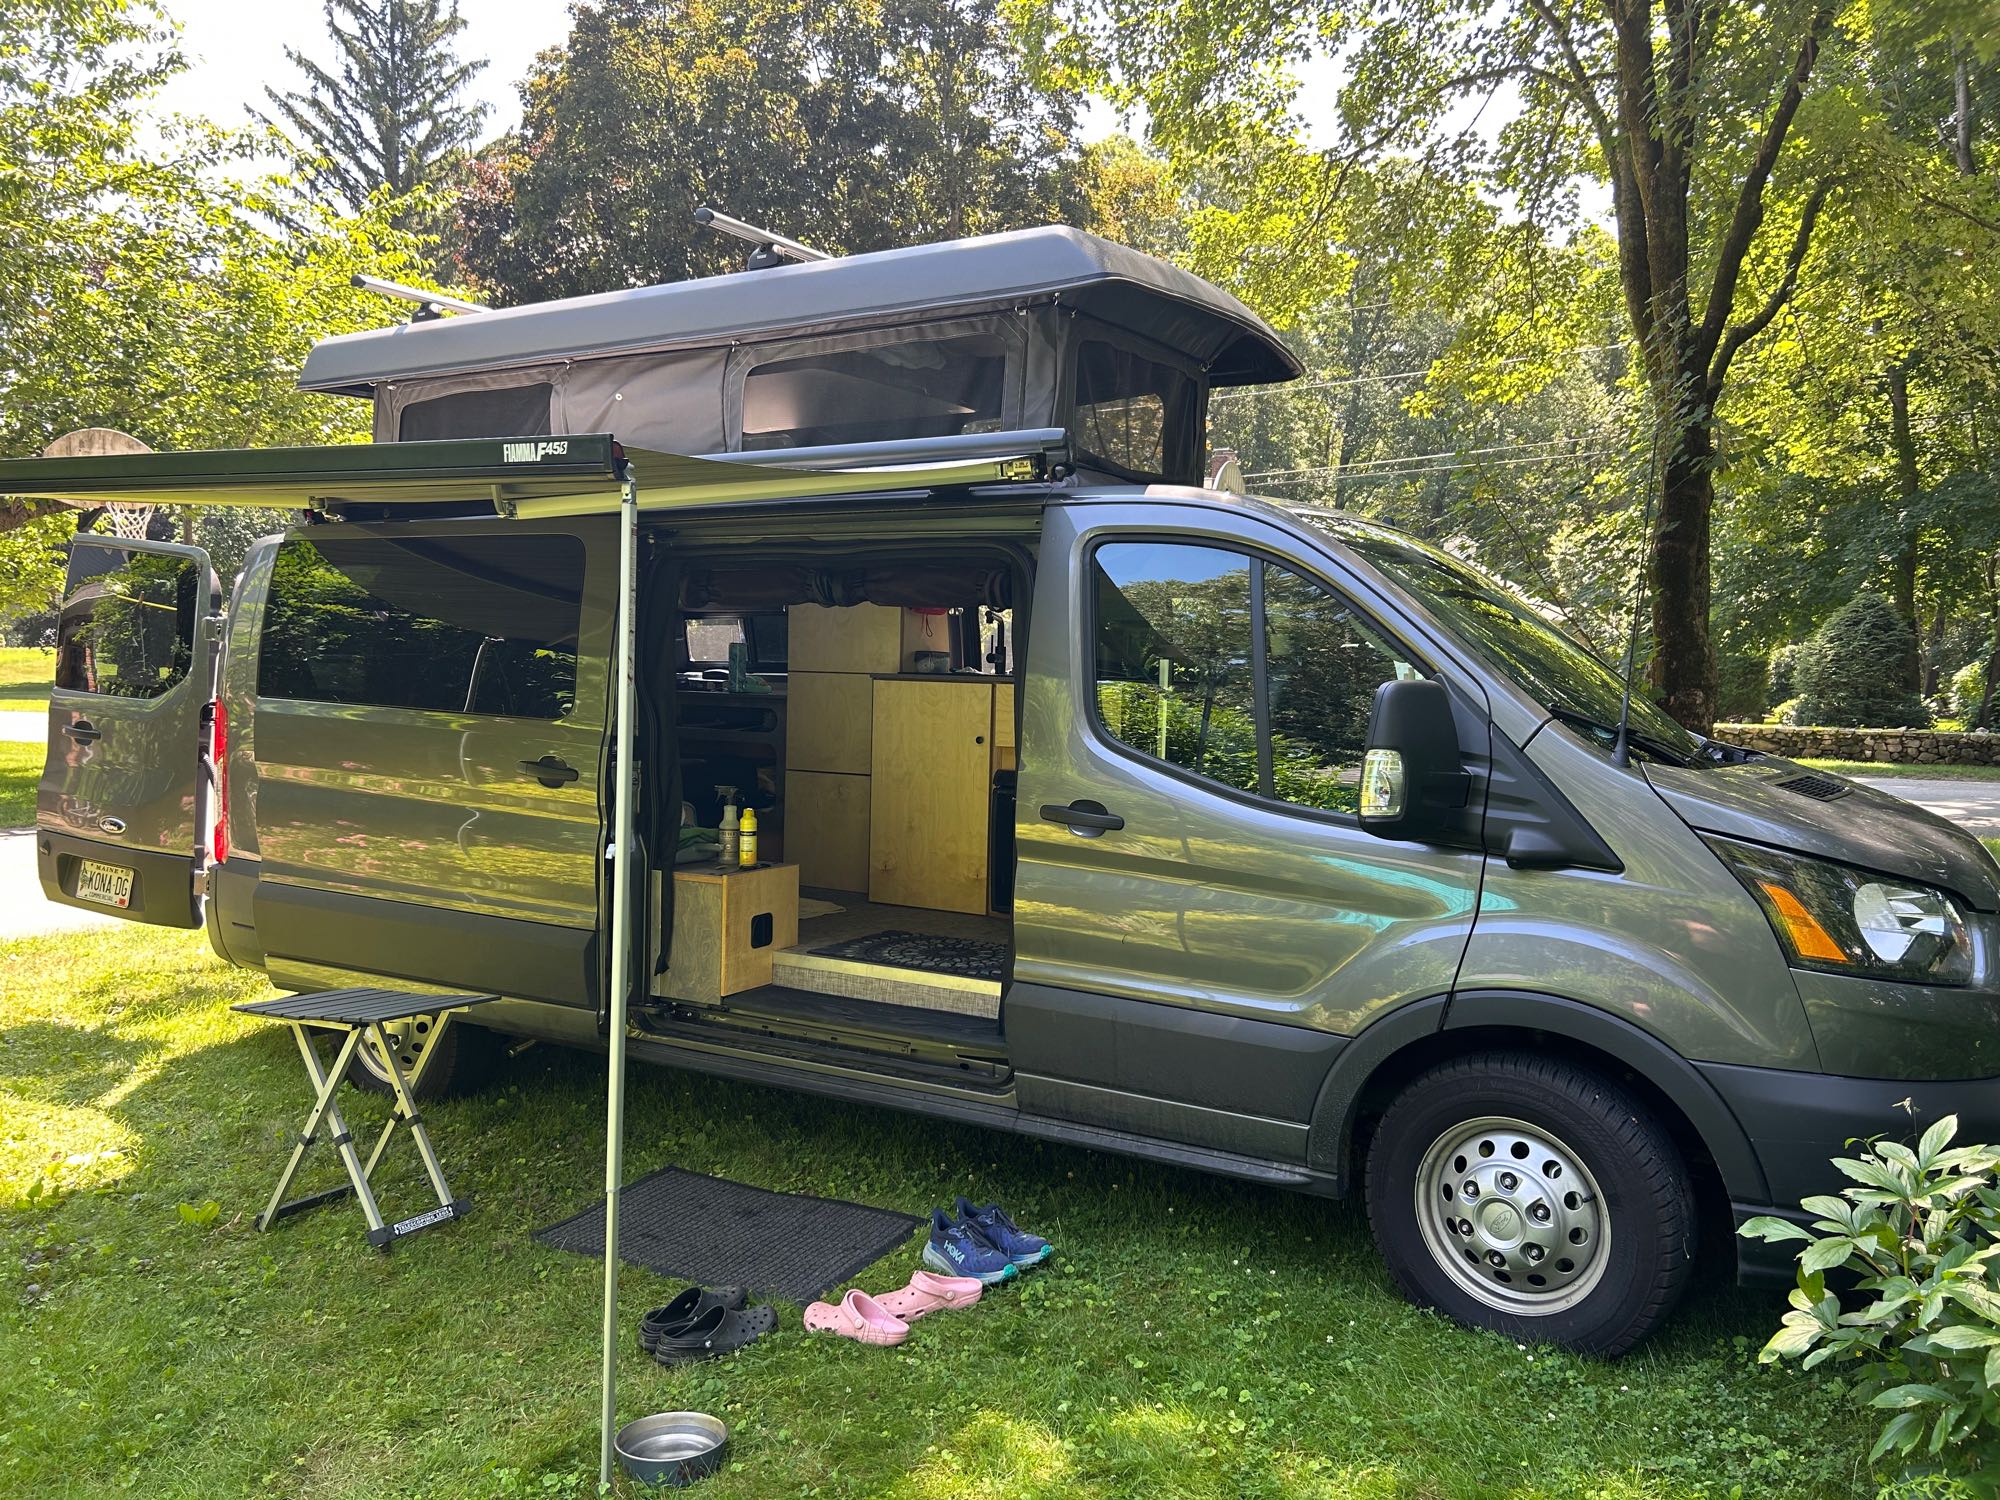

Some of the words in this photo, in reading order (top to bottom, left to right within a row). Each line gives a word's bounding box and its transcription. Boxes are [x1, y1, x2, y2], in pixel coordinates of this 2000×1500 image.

[503, 443, 536, 462] FIAMMA
[96, 864, 119, 874] MAINE
[87, 871, 112, 894] KONA
[943, 1240, 966, 1265] HOKA
